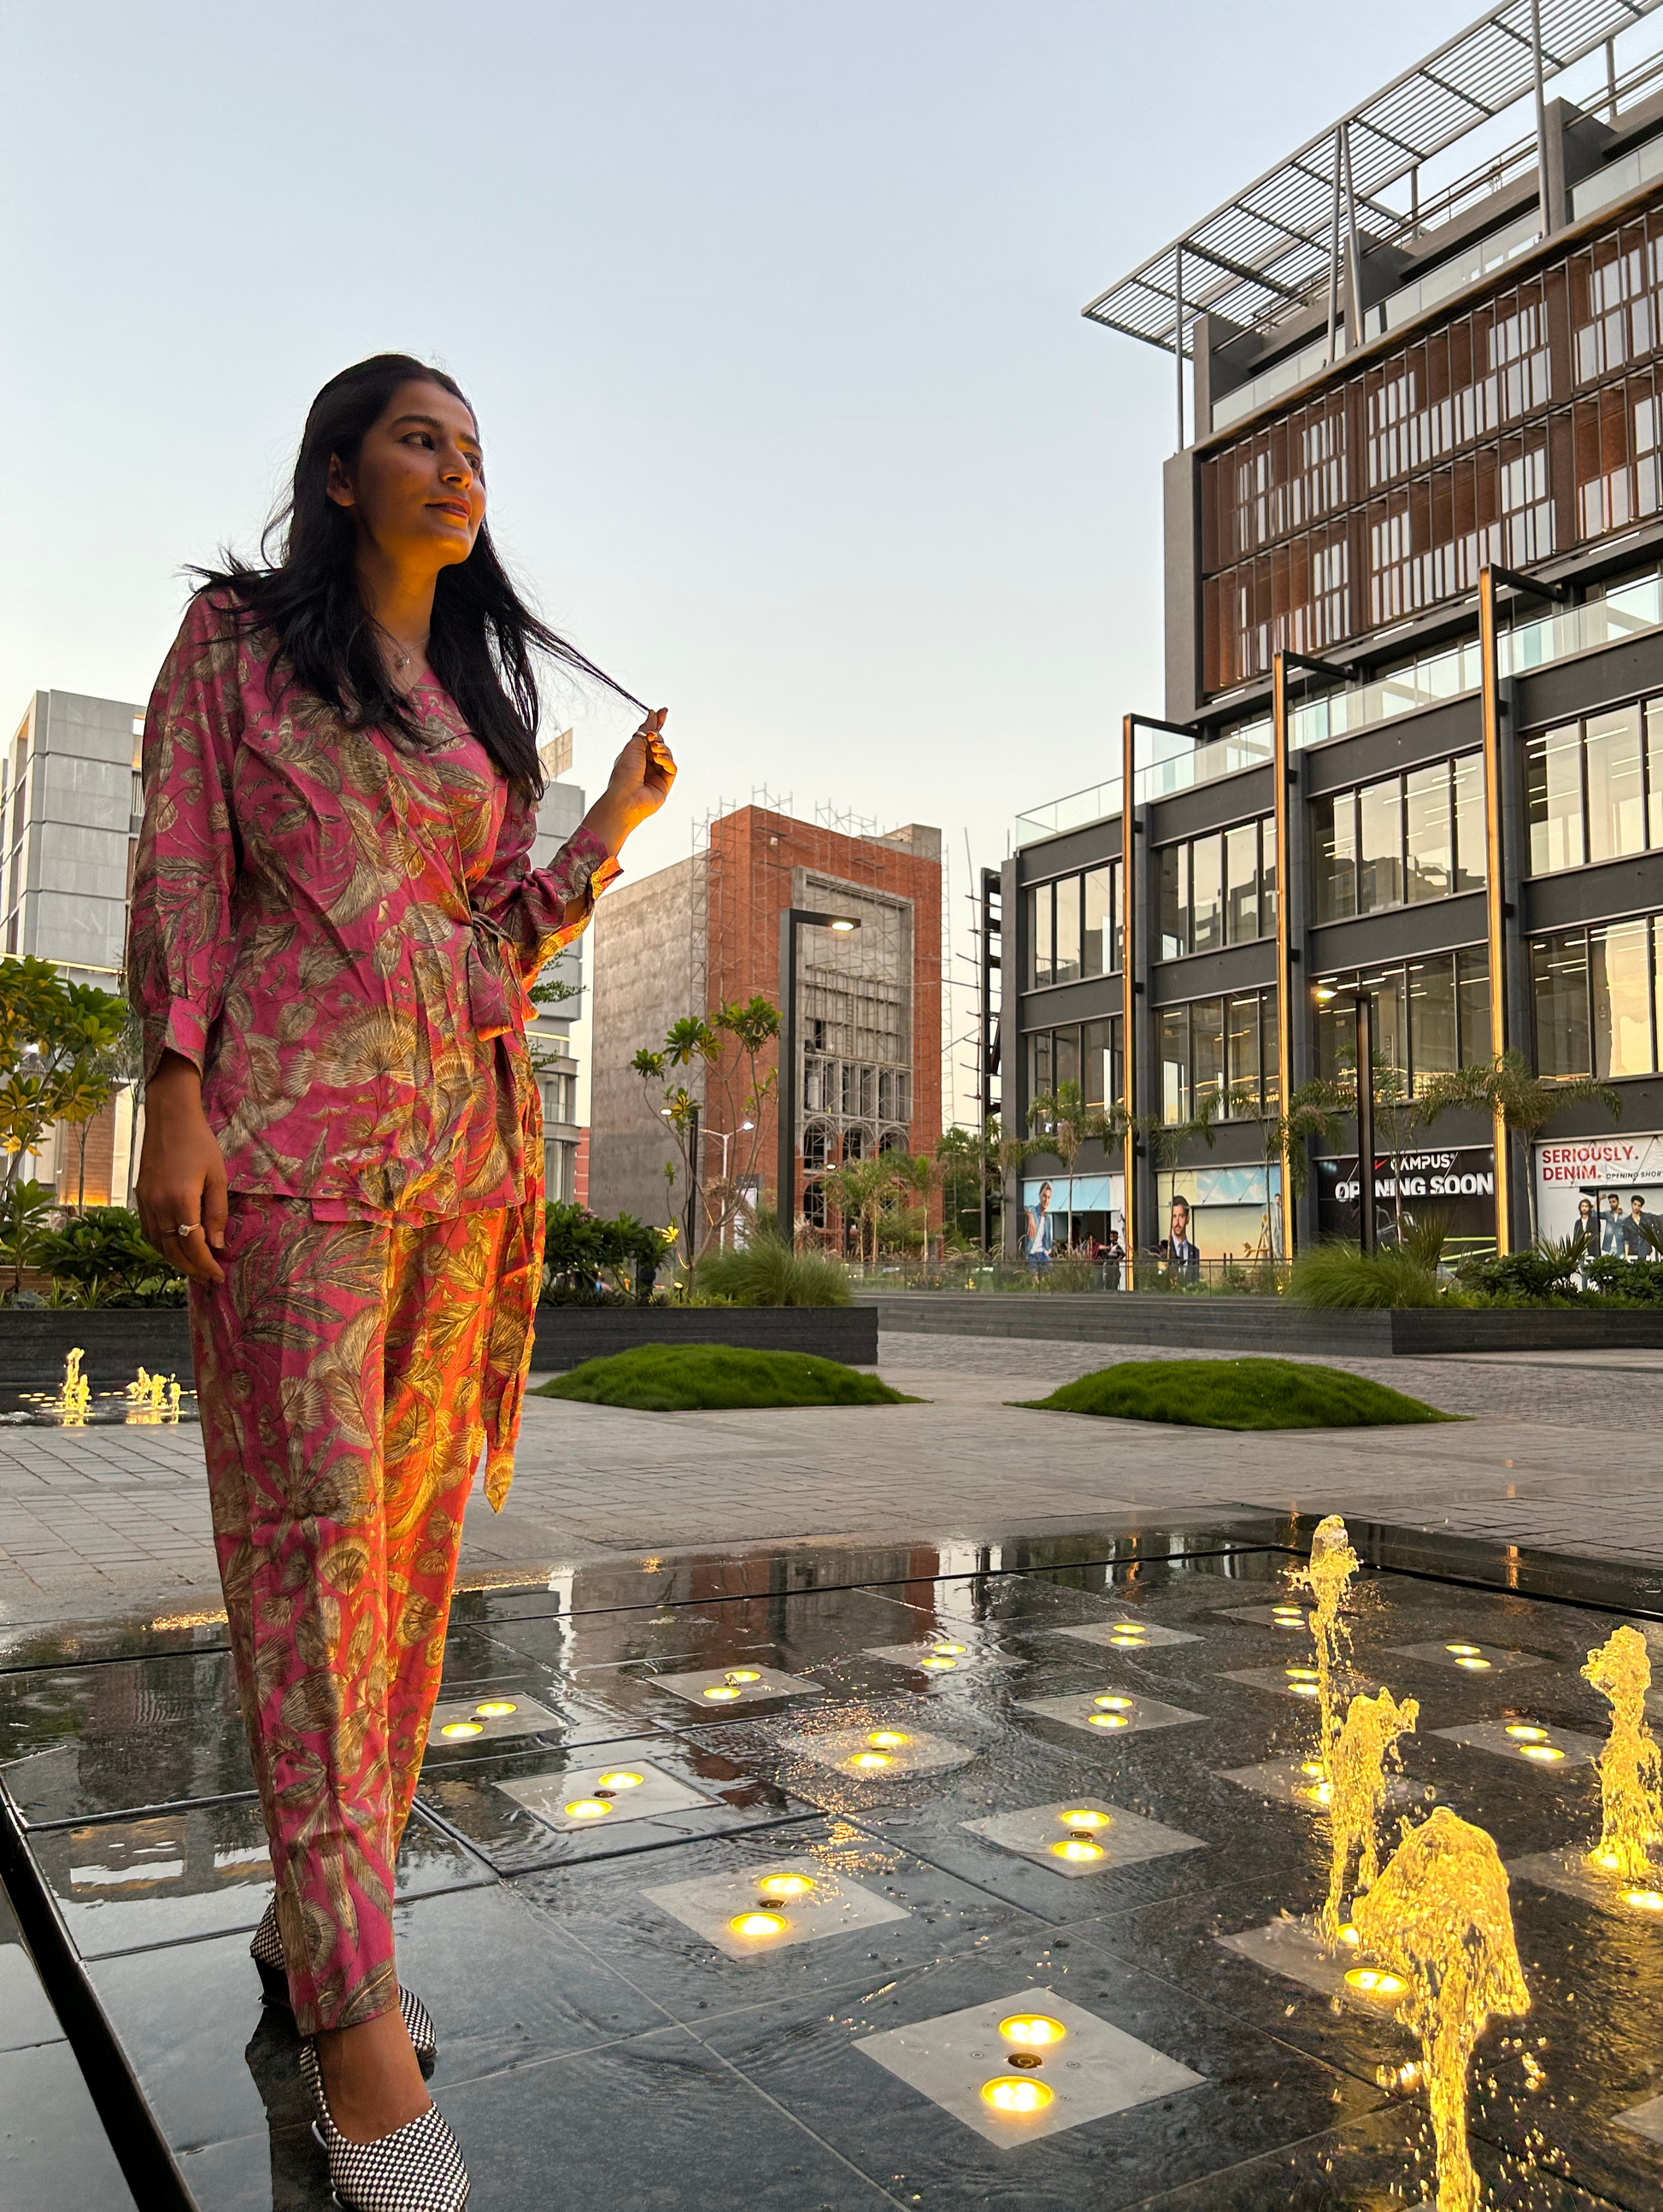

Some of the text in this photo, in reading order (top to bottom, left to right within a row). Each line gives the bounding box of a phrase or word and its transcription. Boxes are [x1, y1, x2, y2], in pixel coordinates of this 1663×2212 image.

[1542, 1145, 1639, 1164] SERIOUSLY.
[1543, 1165, 1602, 1182] DENIM.
[1335, 1171, 1494, 1203] OPNING SOON
